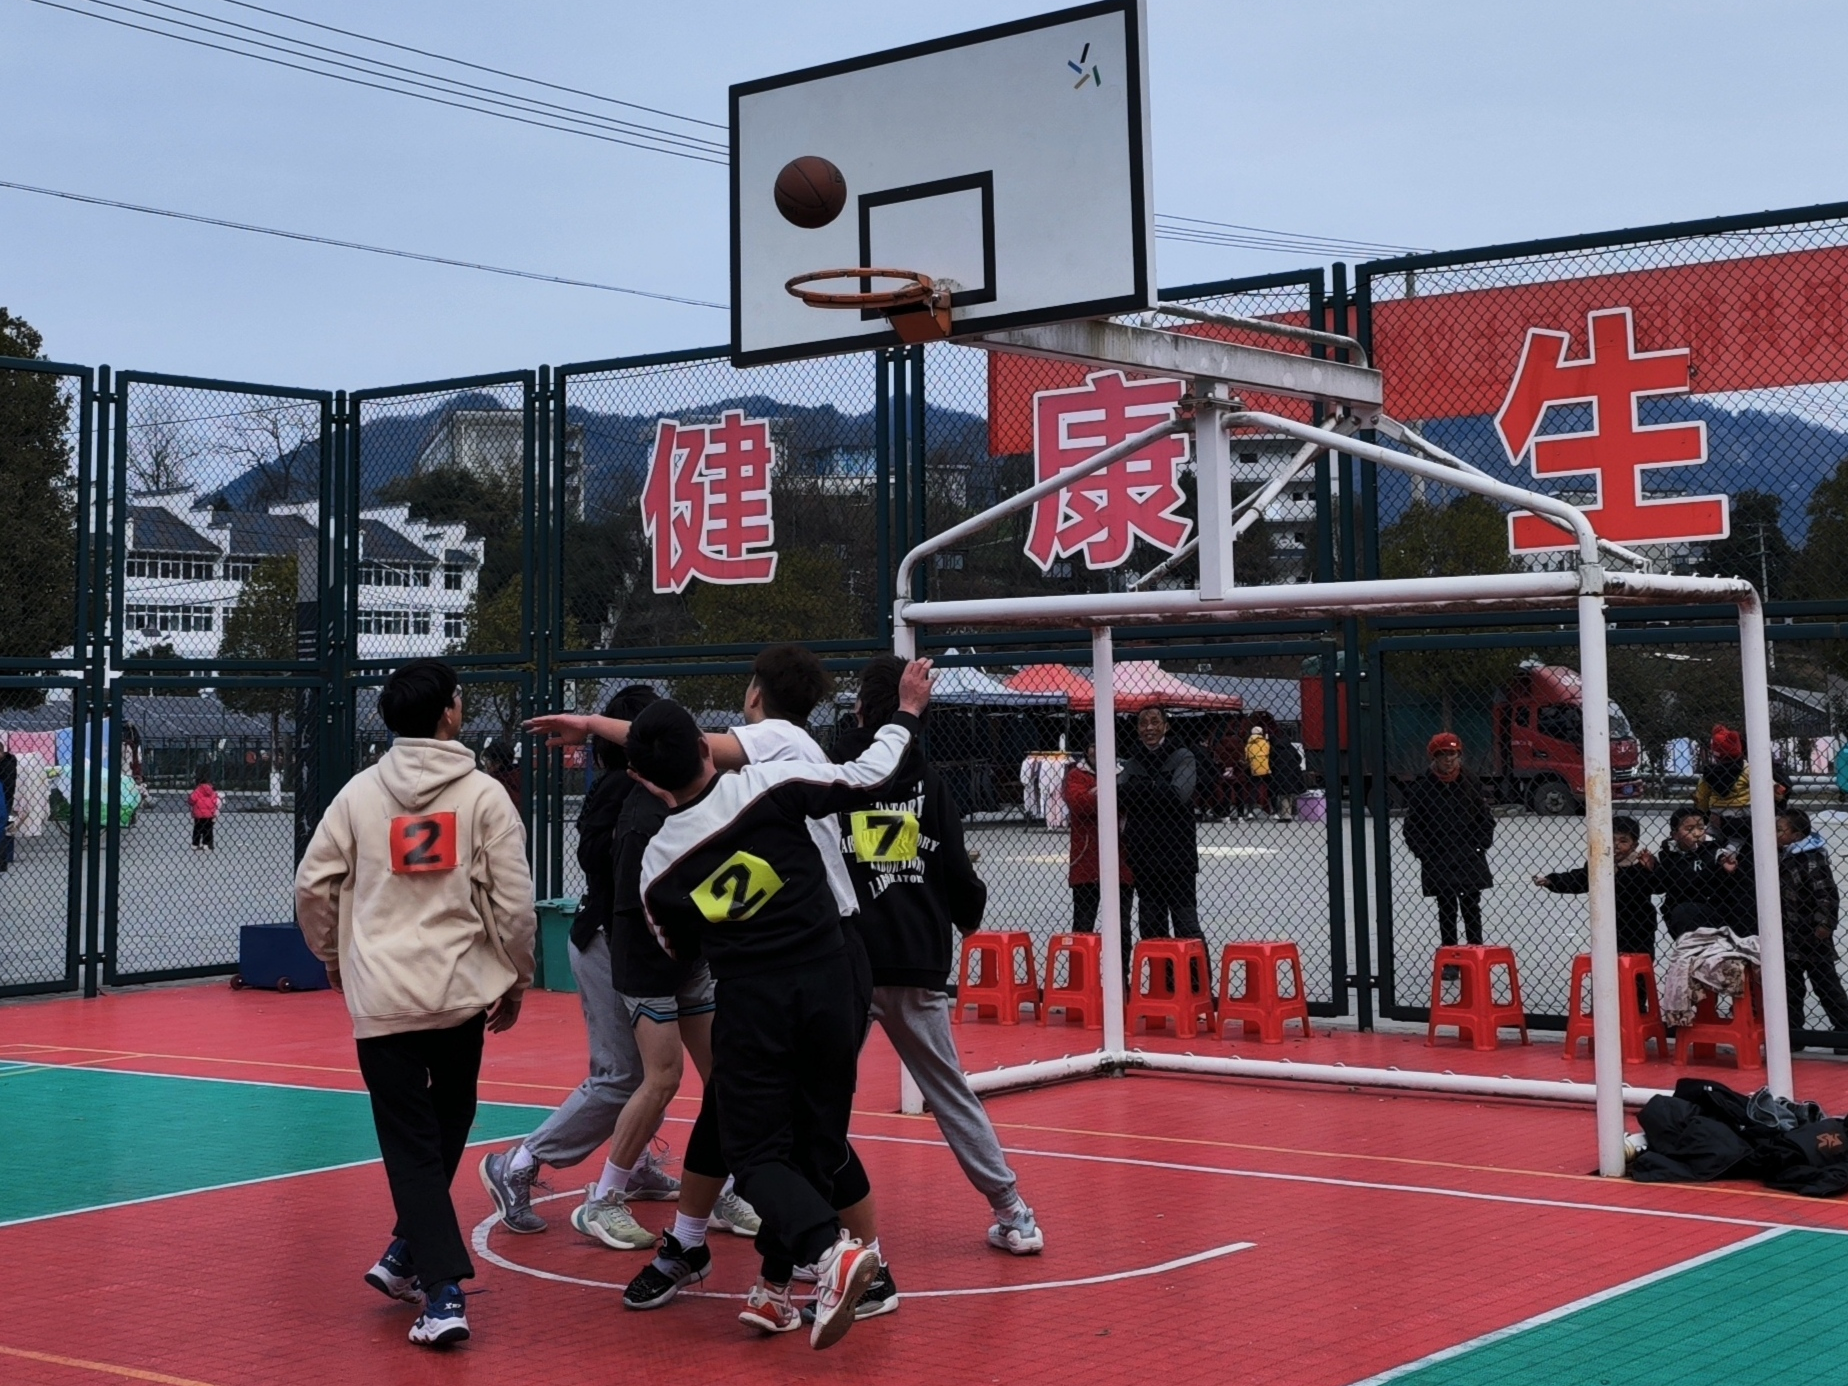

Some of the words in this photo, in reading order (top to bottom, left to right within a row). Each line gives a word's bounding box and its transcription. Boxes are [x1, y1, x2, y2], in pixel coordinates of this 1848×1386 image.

[641, 409, 778, 595] 健
[1023, 369, 1193, 572] 康
[1493, 306, 1730, 555] 生
[402, 819, 443, 866] 2
[866, 815, 905, 857] 7
[1693, 859, 1702, 872] R
[710, 863, 767, 919] 2
